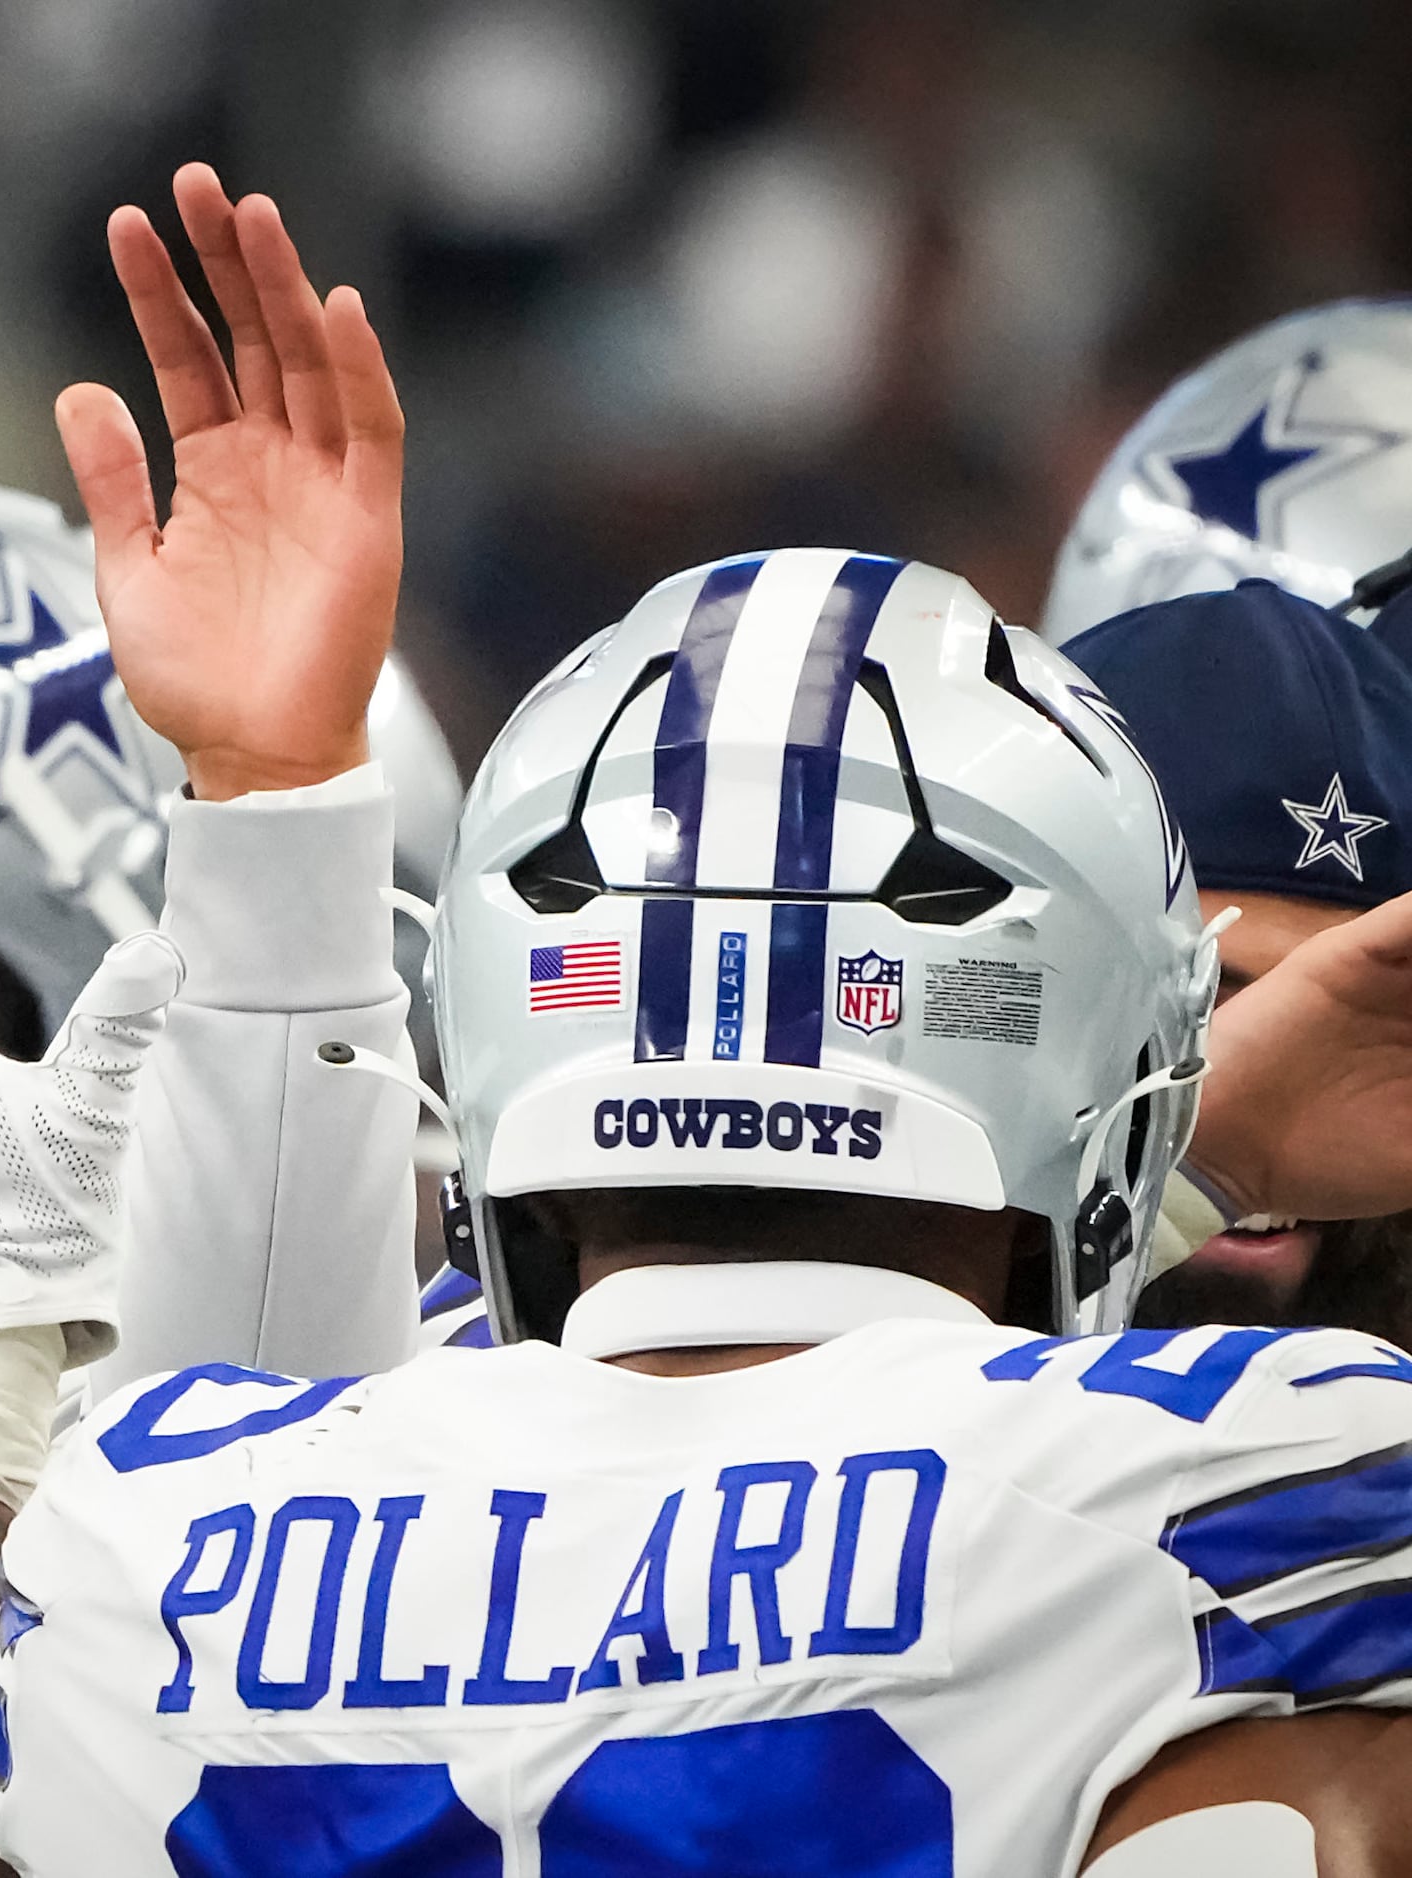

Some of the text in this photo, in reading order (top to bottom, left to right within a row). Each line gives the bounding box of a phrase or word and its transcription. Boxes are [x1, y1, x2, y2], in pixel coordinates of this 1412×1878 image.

[958, 958, 1018, 970] WARNING
[716, 935, 742, 1056] POLLARD
[843, 986, 897, 1026] NFL
[594, 1098, 882, 1160] COWBOYS
[156, 1448, 948, 1714] POLLARD
